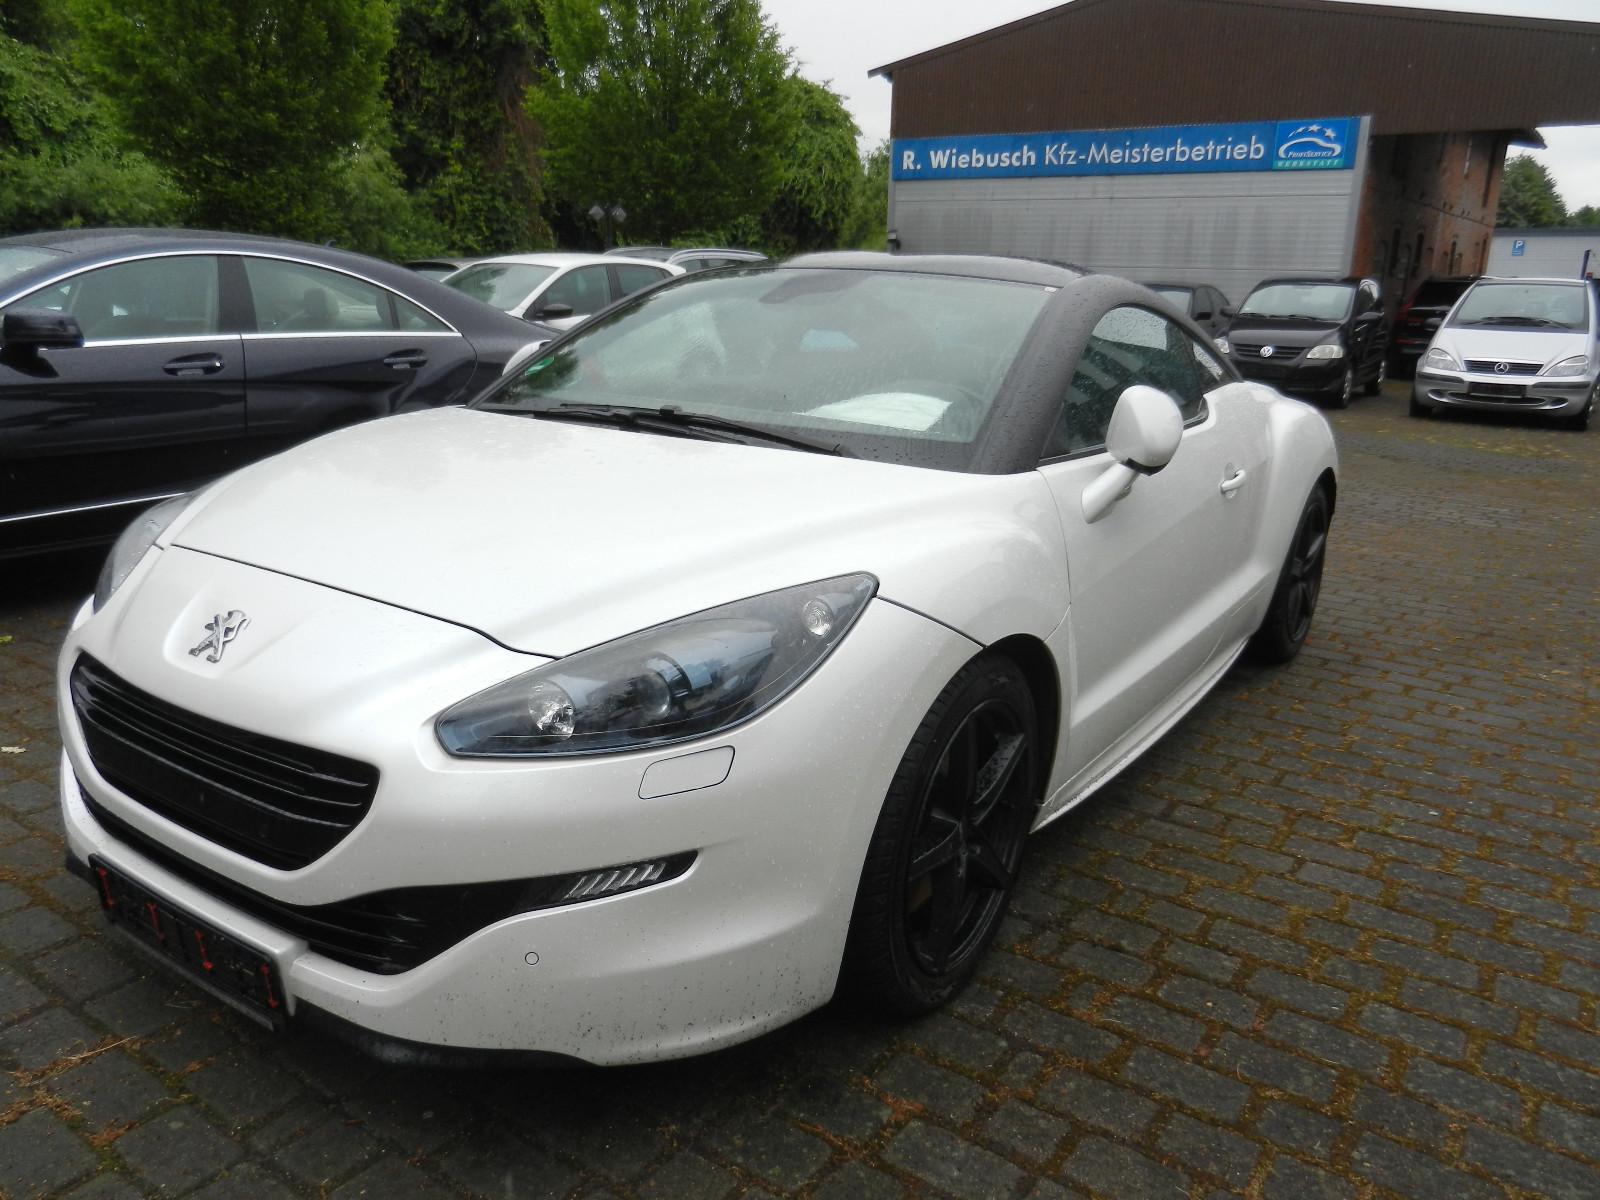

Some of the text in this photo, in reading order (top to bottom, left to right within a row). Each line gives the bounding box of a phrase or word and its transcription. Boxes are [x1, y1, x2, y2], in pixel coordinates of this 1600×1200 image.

[902, 135, 1265, 170] R. Wiebusch Kfz-Meisterbetrieb
